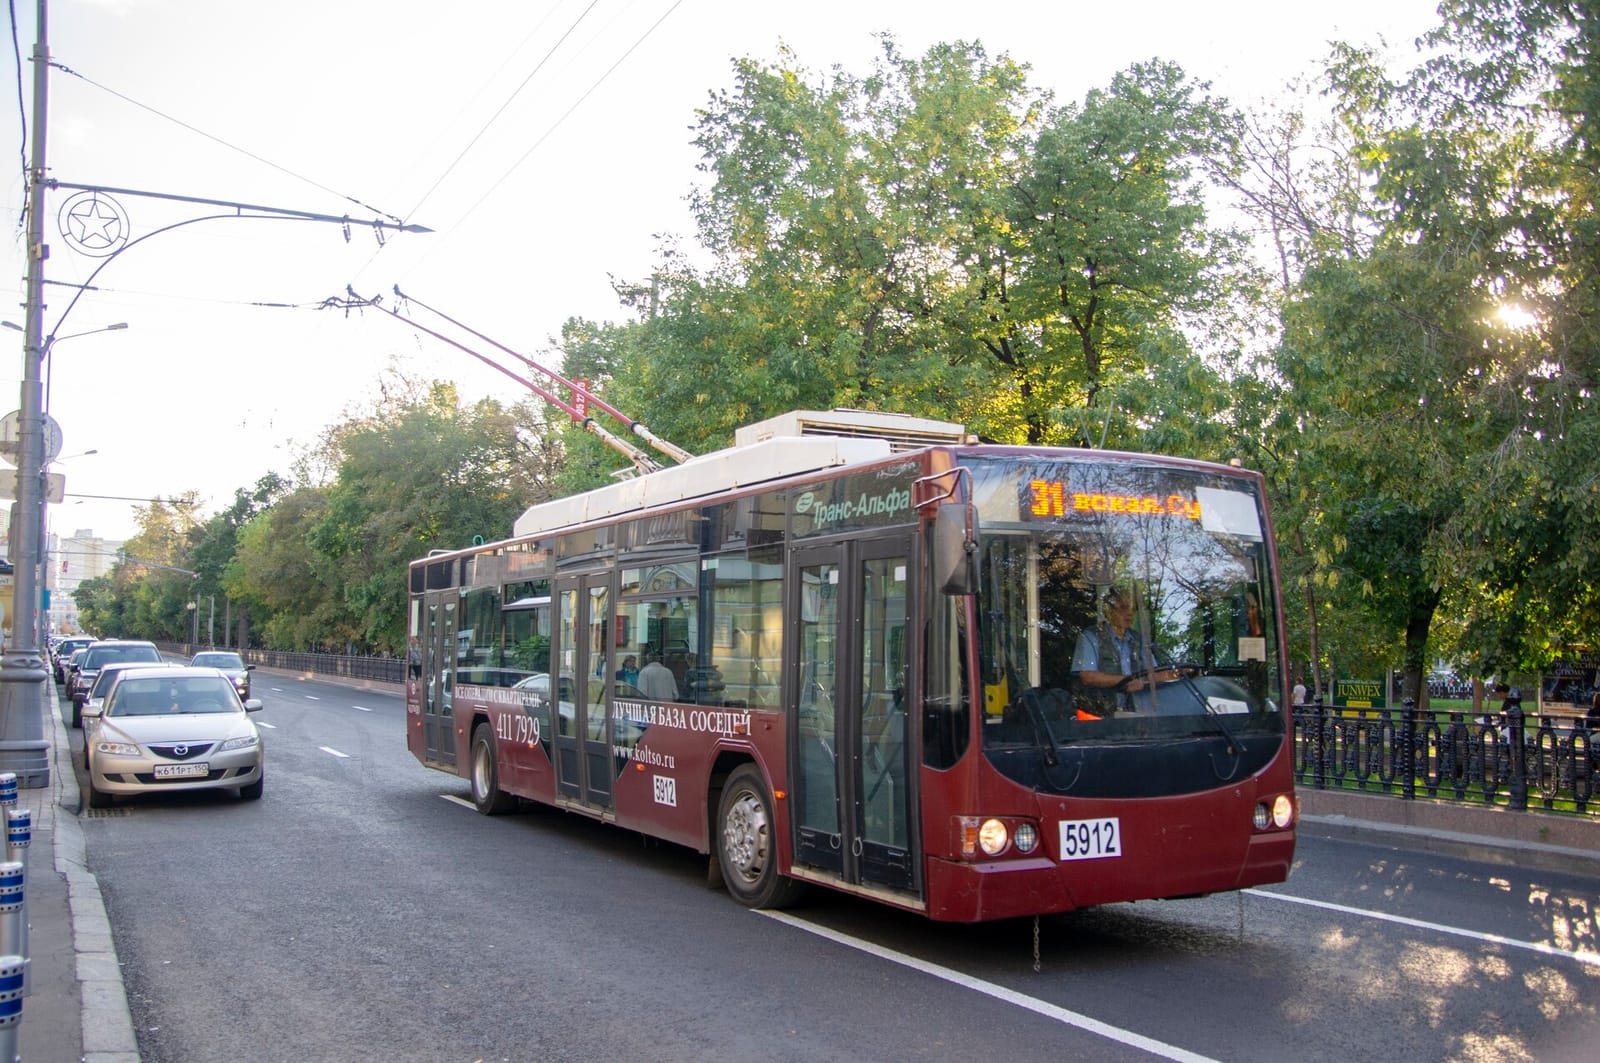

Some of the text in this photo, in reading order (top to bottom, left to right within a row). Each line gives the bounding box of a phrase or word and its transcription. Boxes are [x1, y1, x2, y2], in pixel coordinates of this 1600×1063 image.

[813, 487, 910, 529] Транс-Альфа
[1031, 479, 1064, 517] 31
[1336, 684, 1381, 697] JUNWEX
[496, 713, 540, 746] 411 7929
[612, 701, 752, 738] ЛУЧШАЯ БАЗА СОСЕДЕЙ
[612, 744, 675, 769] www.koltso.ru
[655, 778, 675, 803] 5912
[1066, 821, 1116, 856] 5912
